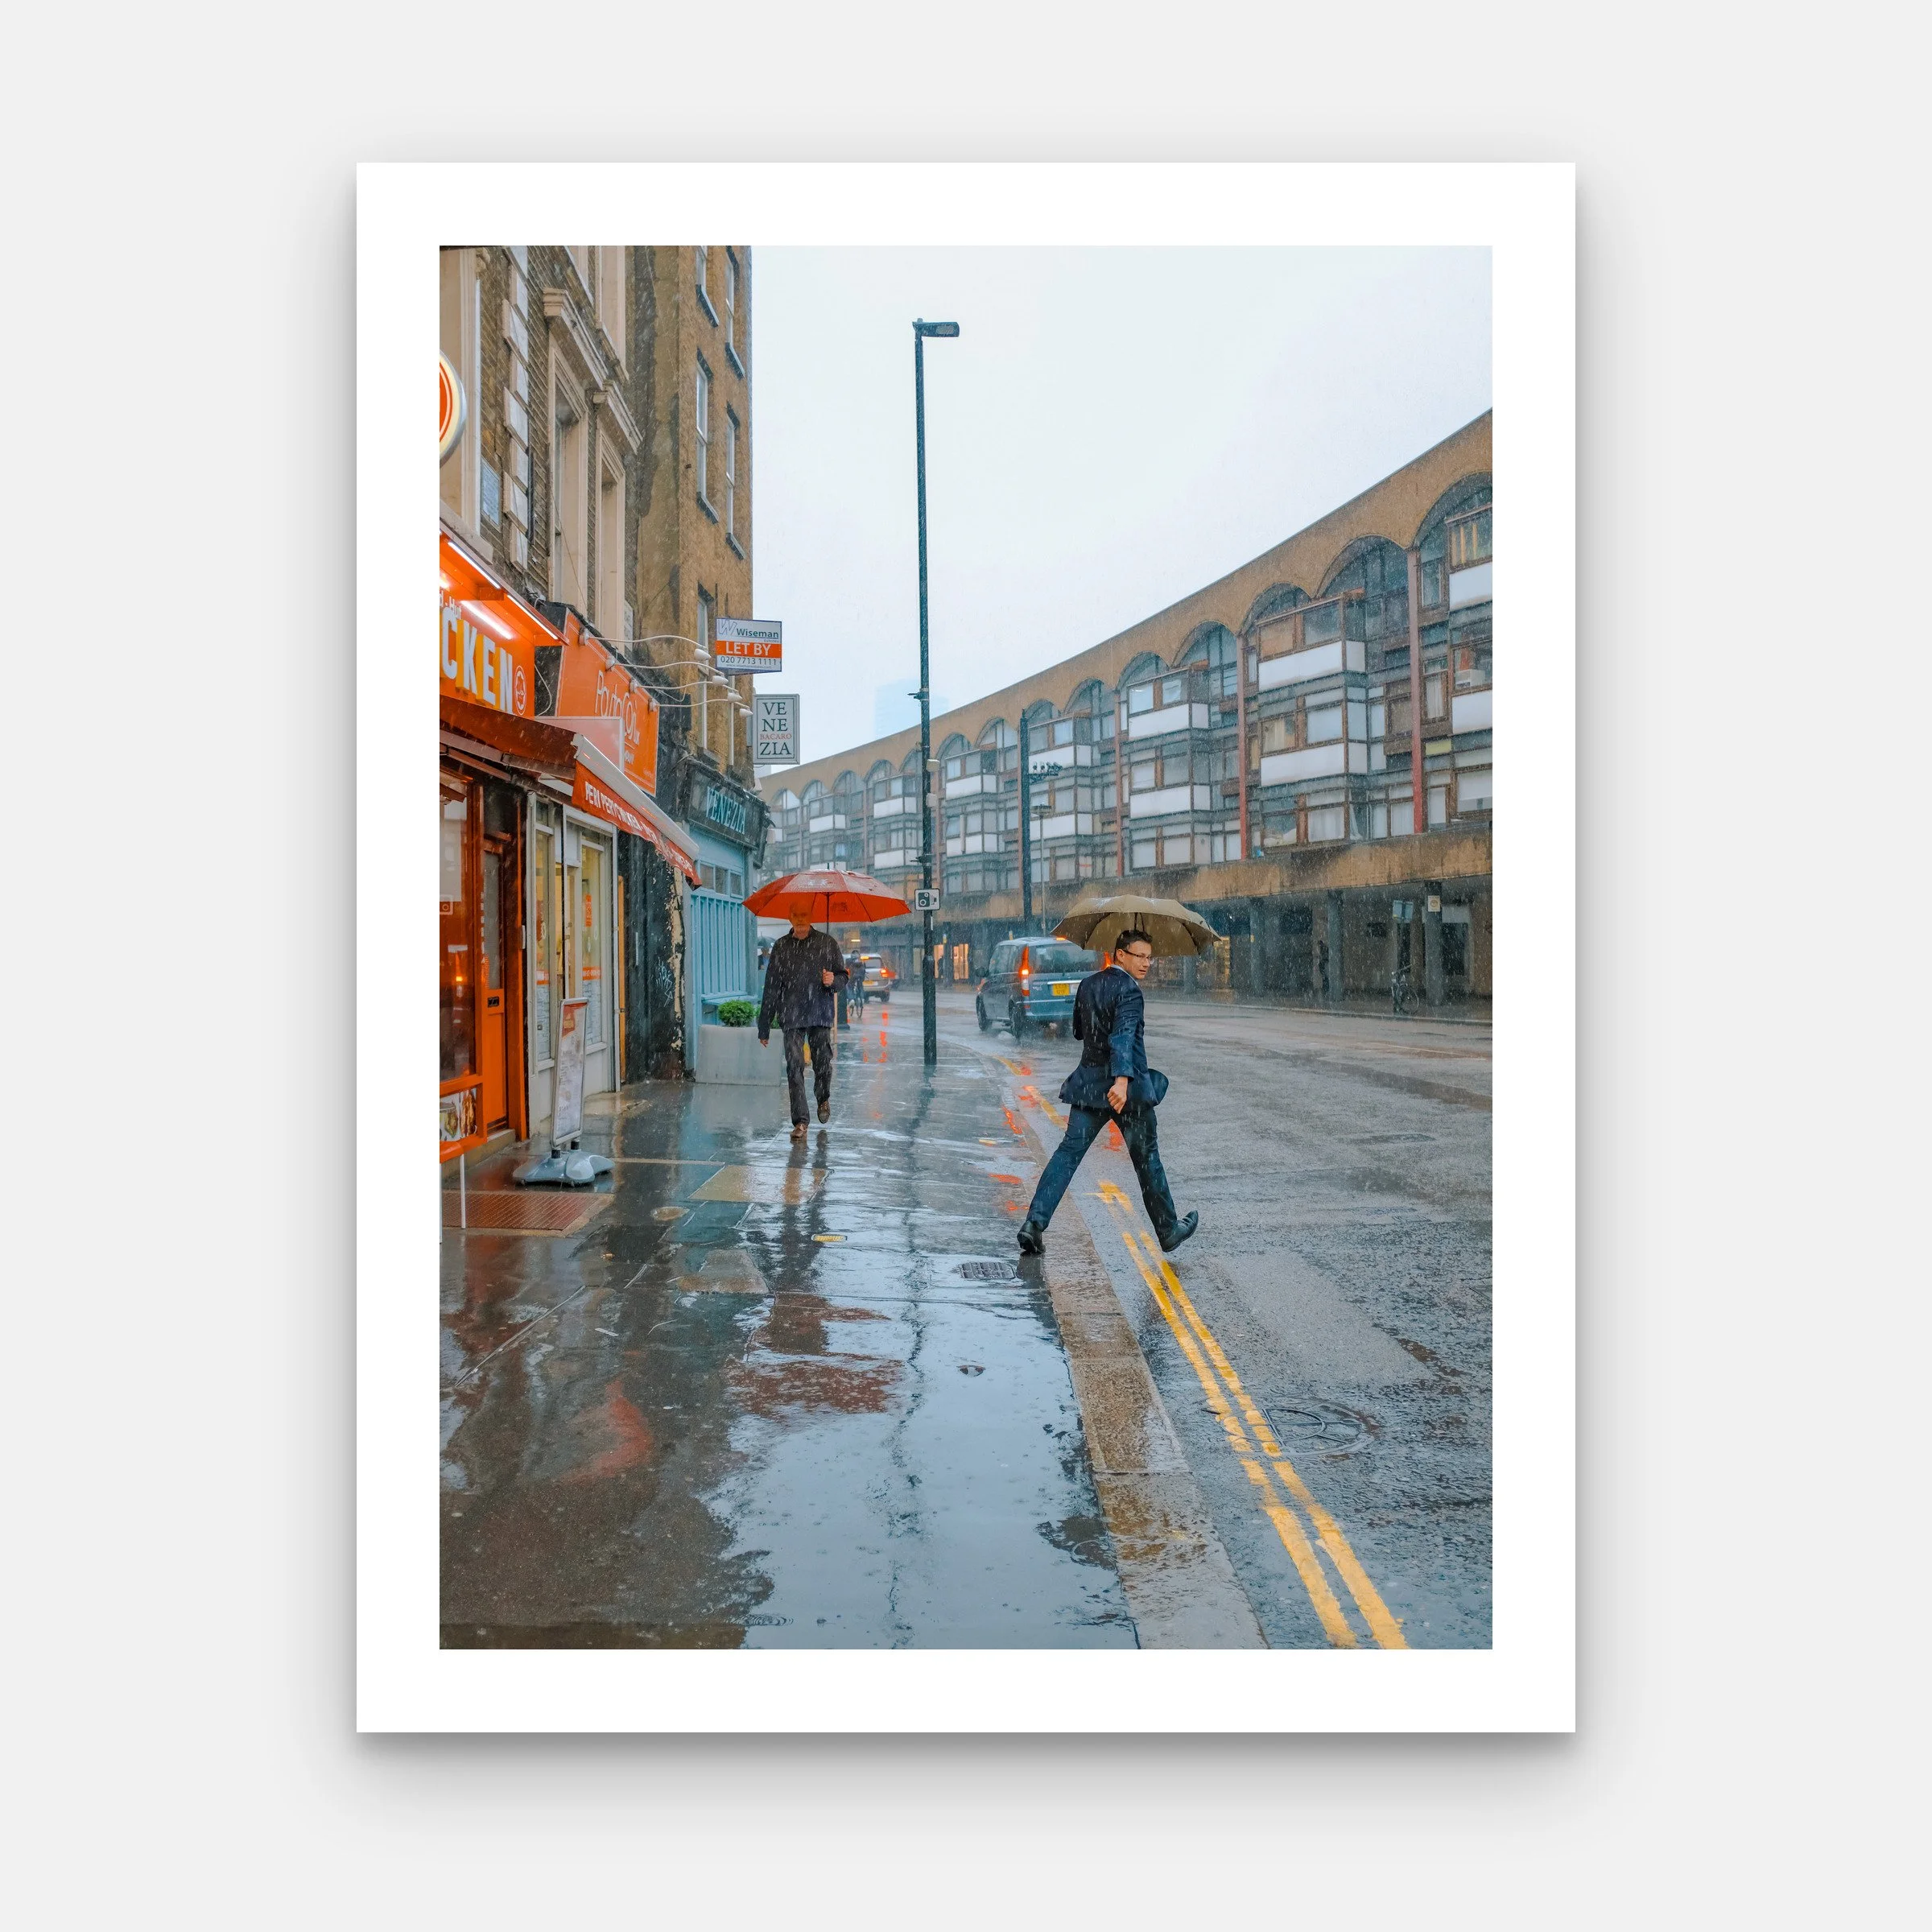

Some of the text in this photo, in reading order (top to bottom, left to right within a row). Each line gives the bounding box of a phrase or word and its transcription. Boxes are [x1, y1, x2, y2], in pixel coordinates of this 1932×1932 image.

[737, 628, 779, 638] Wiseman
[725, 641, 771, 656] LET BY
[737, 657, 756, 665] 7713
[759, 658, 777, 666] 1111
[762, 702, 787, 716] VE
[762, 718, 788, 732] NE
[759, 741, 792, 756] ZIA
[585, 781, 601, 809] PERI
[706, 786, 746, 835] VENEZIA
